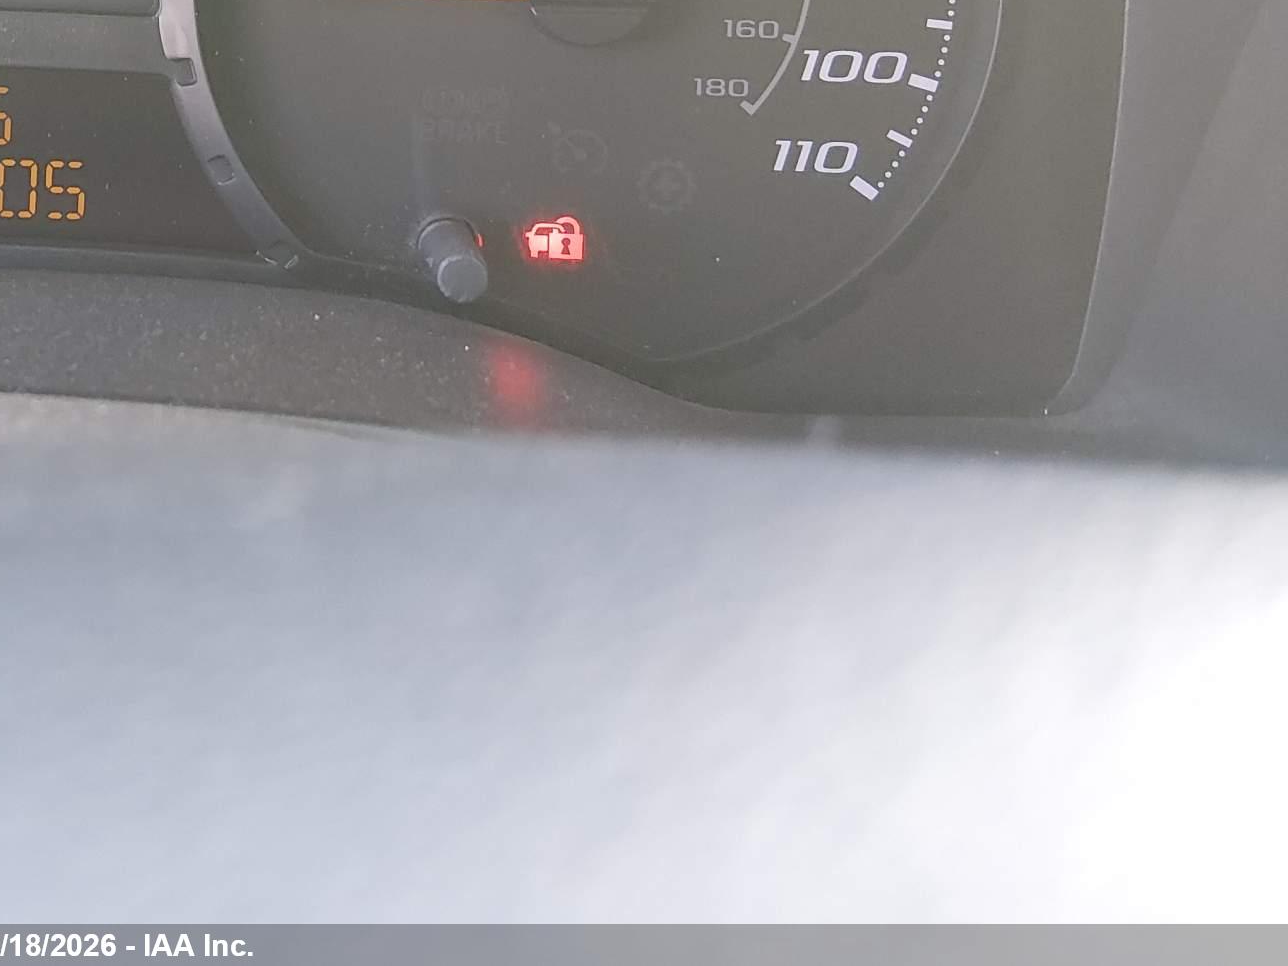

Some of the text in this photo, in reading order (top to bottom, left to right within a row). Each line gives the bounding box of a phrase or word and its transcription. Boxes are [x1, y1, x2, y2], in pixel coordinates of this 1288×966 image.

[723, 19, 780, 39] 160
[801, 49, 909, 85] 100
[693, 77, 749, 97] 180
[773, 139, 858, 174] 110
